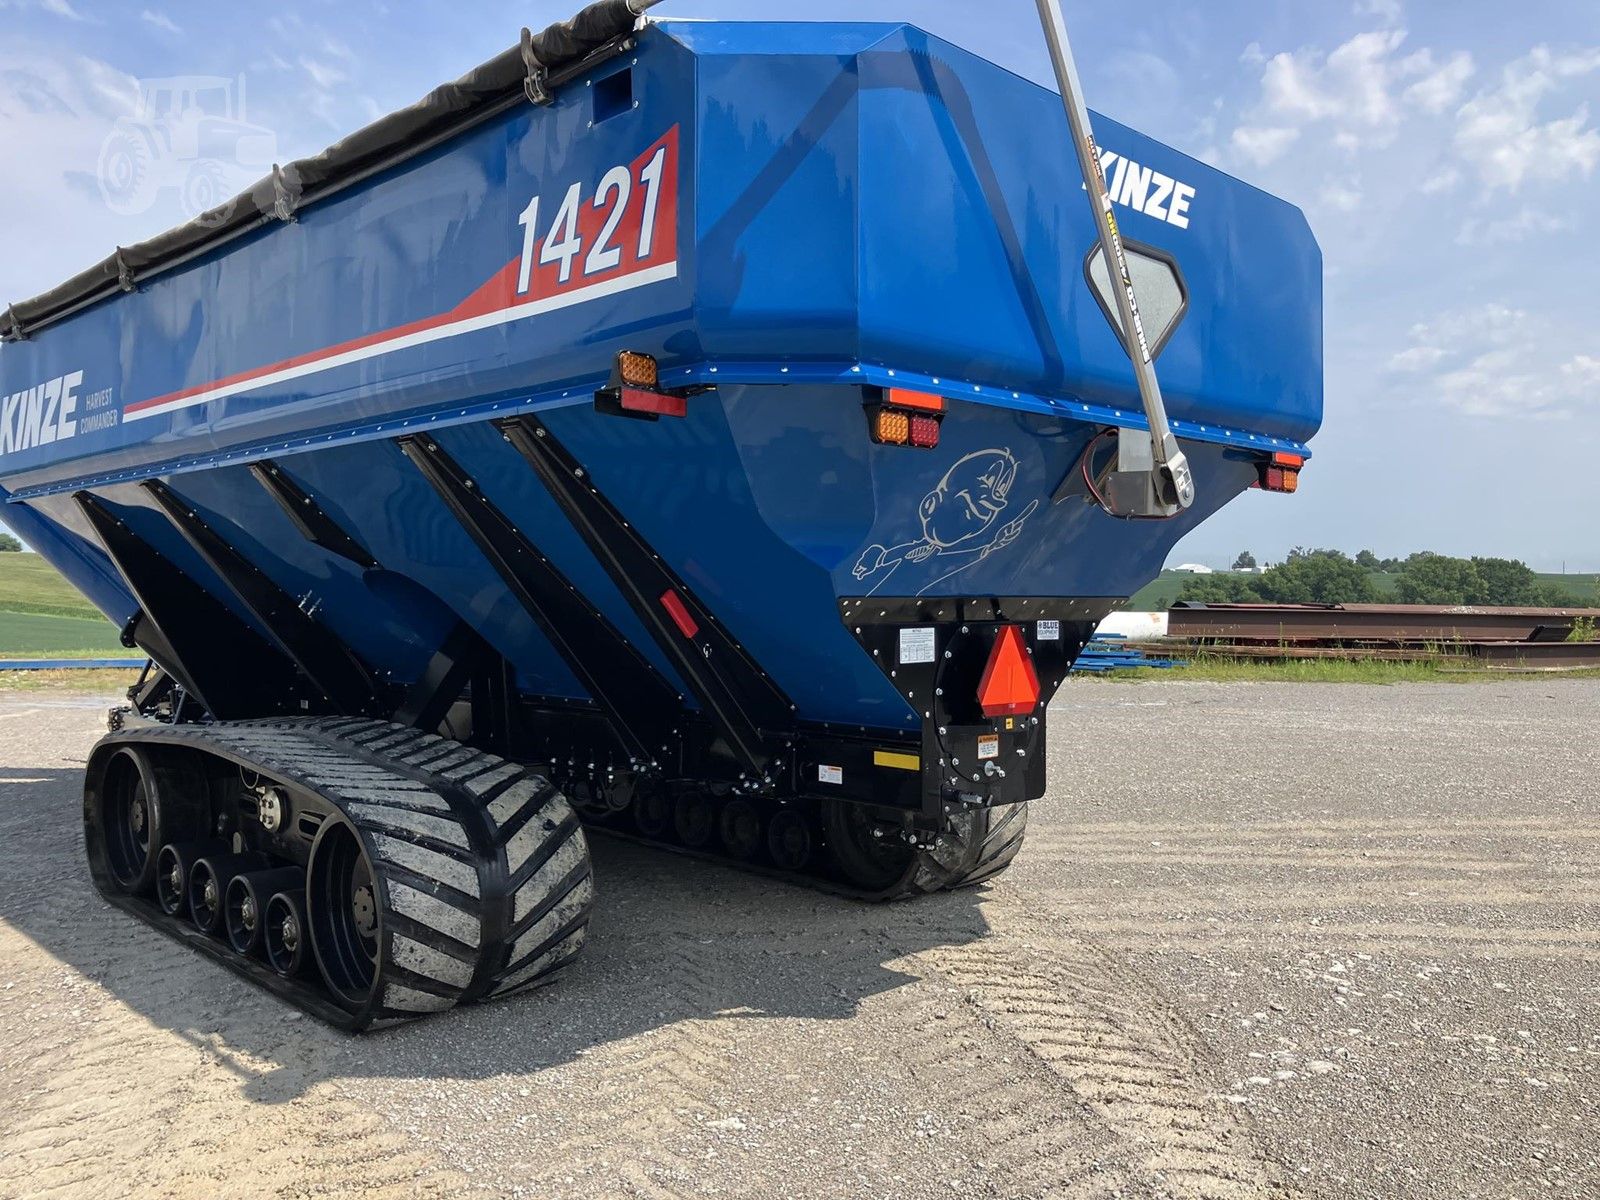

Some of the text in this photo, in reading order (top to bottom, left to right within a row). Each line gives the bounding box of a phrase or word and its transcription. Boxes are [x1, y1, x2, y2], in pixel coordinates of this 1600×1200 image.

[517, 147, 665, 294] 1421
[86, 387, 113, 411] HARVEST
[0, 369, 84, 456] KINZE
[81, 409, 118, 434] COMMANDER
[1043, 621, 1058, 629] BLUE
